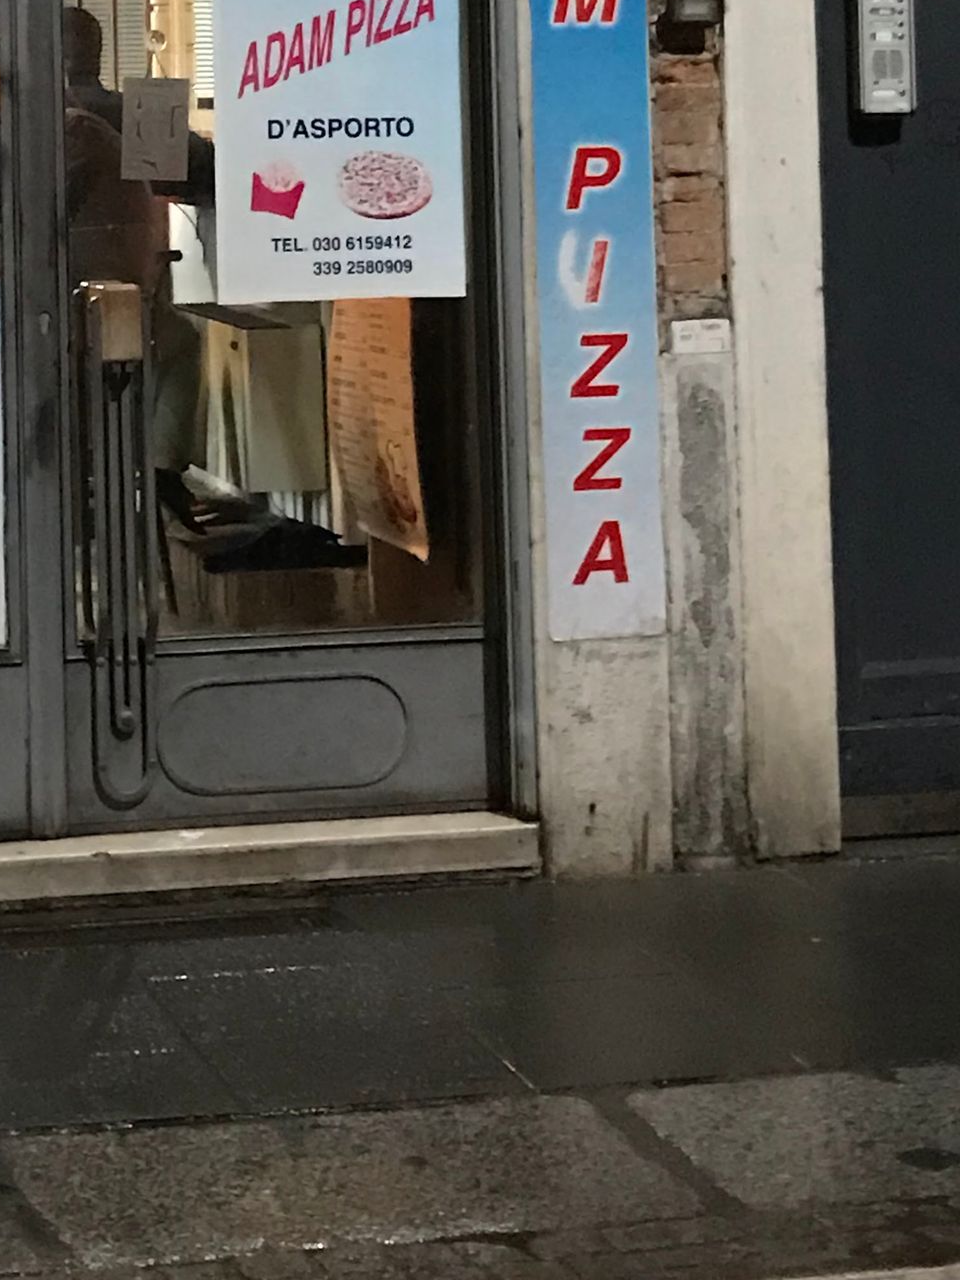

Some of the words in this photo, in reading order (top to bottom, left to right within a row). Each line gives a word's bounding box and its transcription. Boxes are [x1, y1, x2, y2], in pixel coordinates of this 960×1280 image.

[238, 9, 336, 99] ADAM
[267, 117, 415, 140] D'ASPORTO
[272, 238, 308, 253] TEL.
[313, 237, 341, 252] 030
[345, 235, 413, 251] 6159412
[313, 261, 340, 276] 339
[347, 259, 413, 275] 2580909
[565, 146, 632, 585] PIZZA
